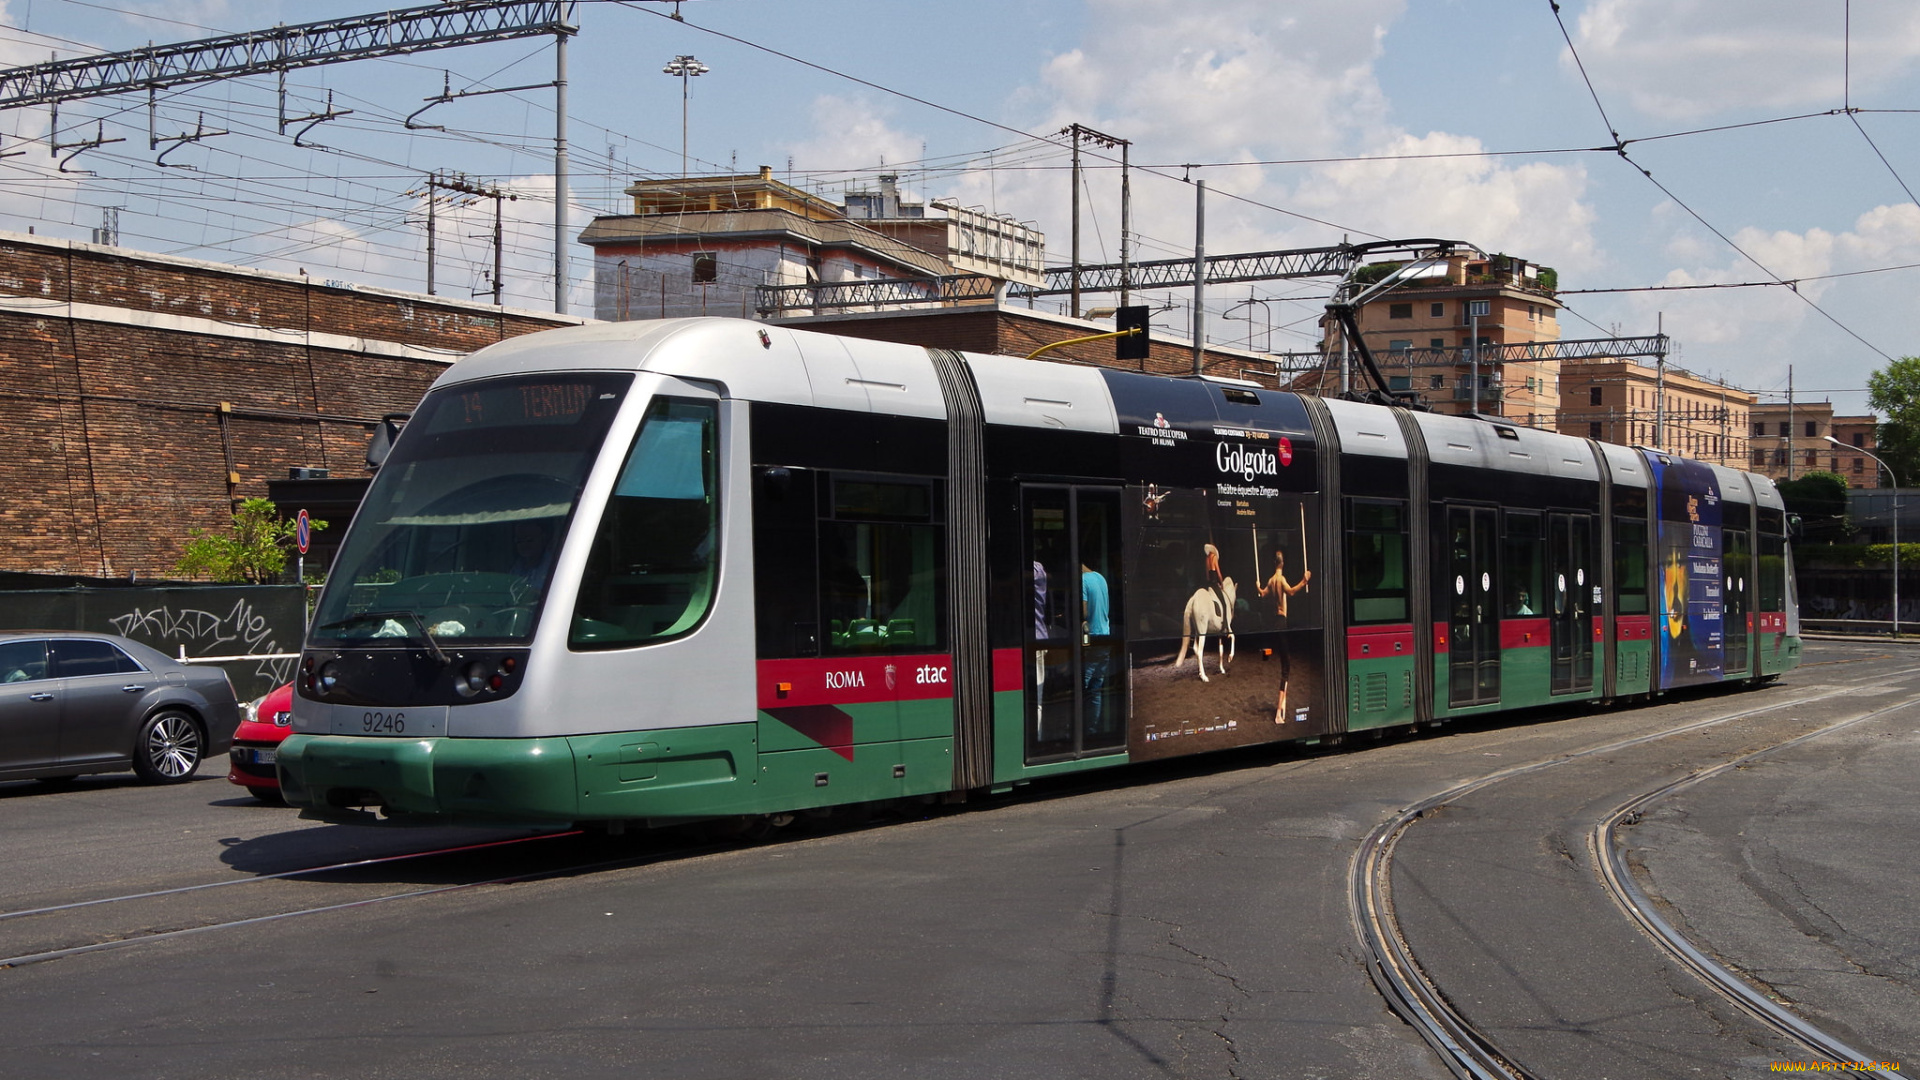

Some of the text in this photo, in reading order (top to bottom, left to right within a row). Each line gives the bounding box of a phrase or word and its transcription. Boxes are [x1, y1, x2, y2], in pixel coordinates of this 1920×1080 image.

[462, 391, 482, 423] 14
[1138, 426, 1188, 440] TEATRO DELL'OPERA
[1216, 441, 1277, 482] Golgota
[825, 664, 947, 689] ROMA atac
[363, 711, 405, 733] 9246
